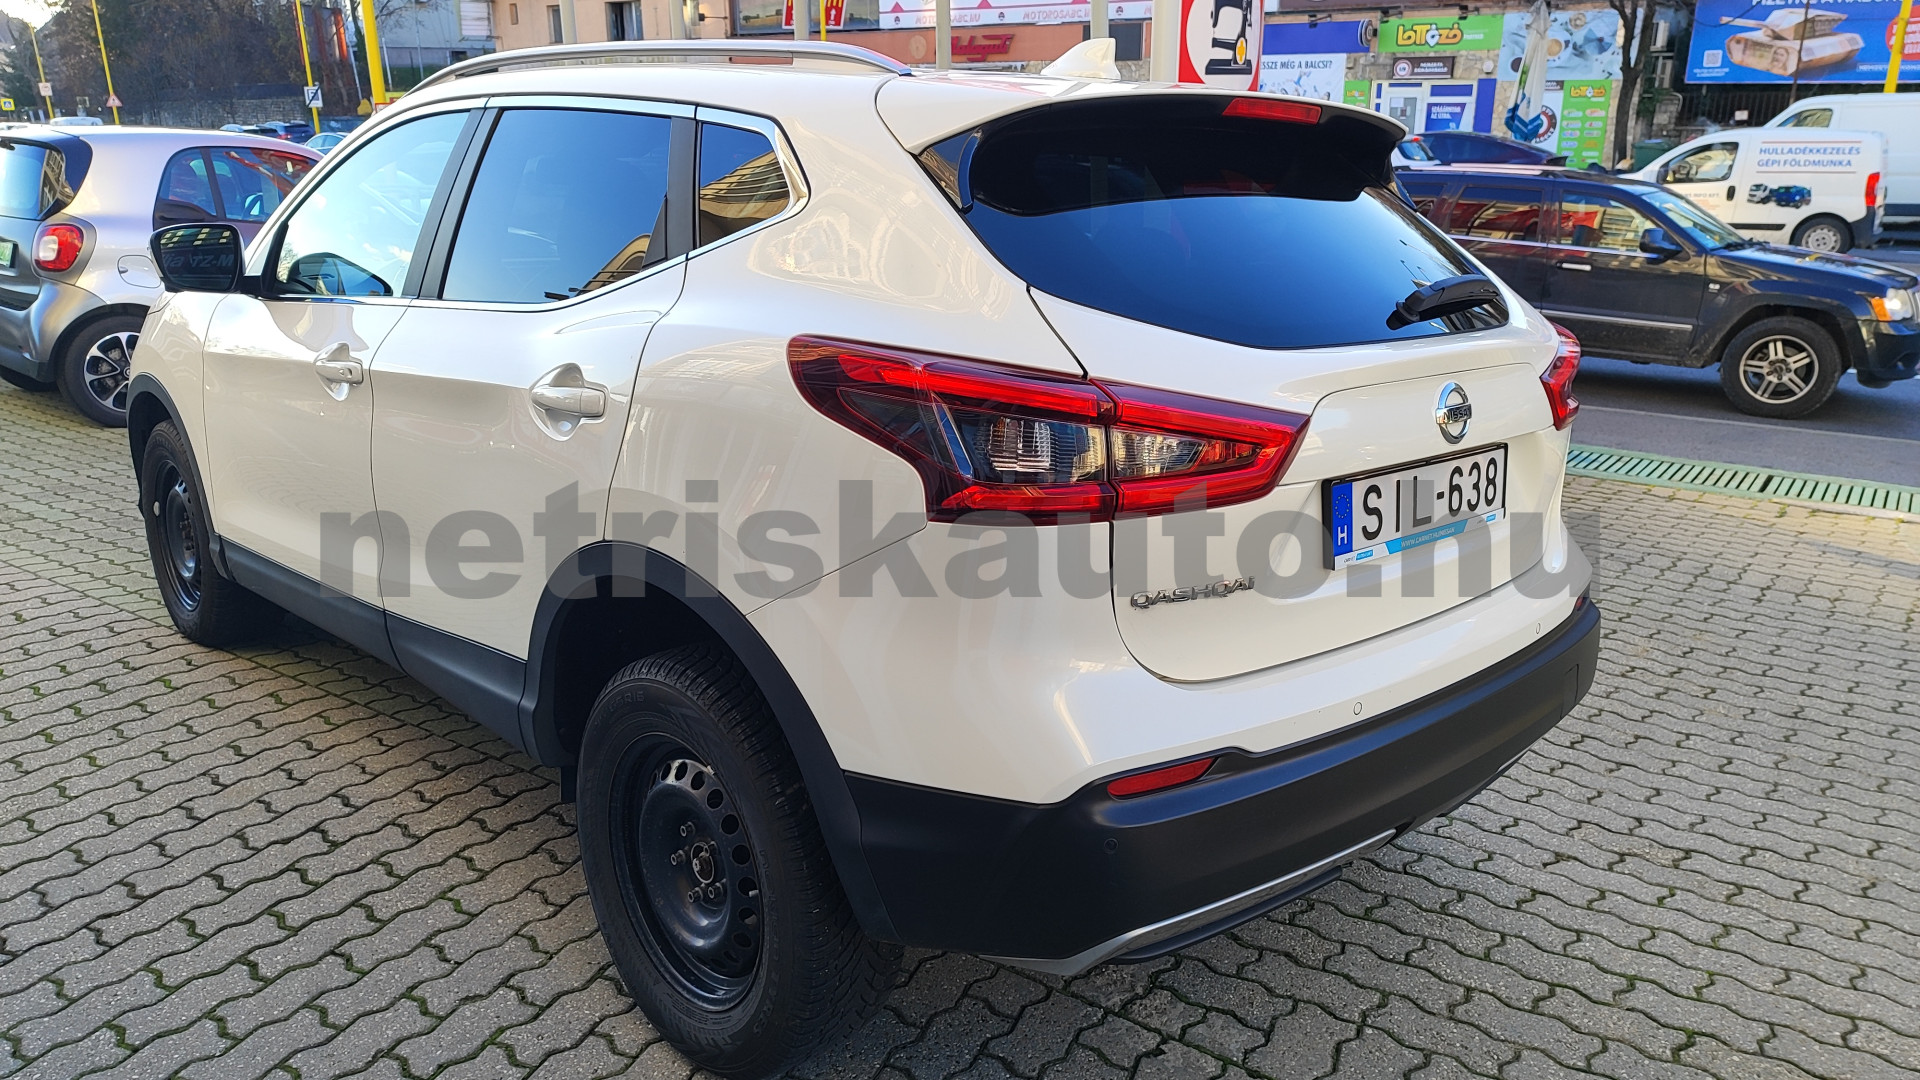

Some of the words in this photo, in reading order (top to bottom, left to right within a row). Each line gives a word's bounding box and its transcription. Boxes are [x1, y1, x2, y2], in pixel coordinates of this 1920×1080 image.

[1023, 8, 1090, 20] MOTOROSABC.H
[1279, 59, 1295, 69] MÉG
[1298, 61, 1302, 69] A
[1305, 60, 1333, 69] BALCSI?
[1759, 146, 1861, 156] HULLADÉKKEZELÉS
[1757, 157, 1781, 168] GÉPI
[1783, 158, 1852, 168] FÖLDMUNKA
[1361, 457, 1498, 541] SIL-638
[1337, 524, 1348, 546] H
[1130, 576, 1255, 609] QASHQAI
